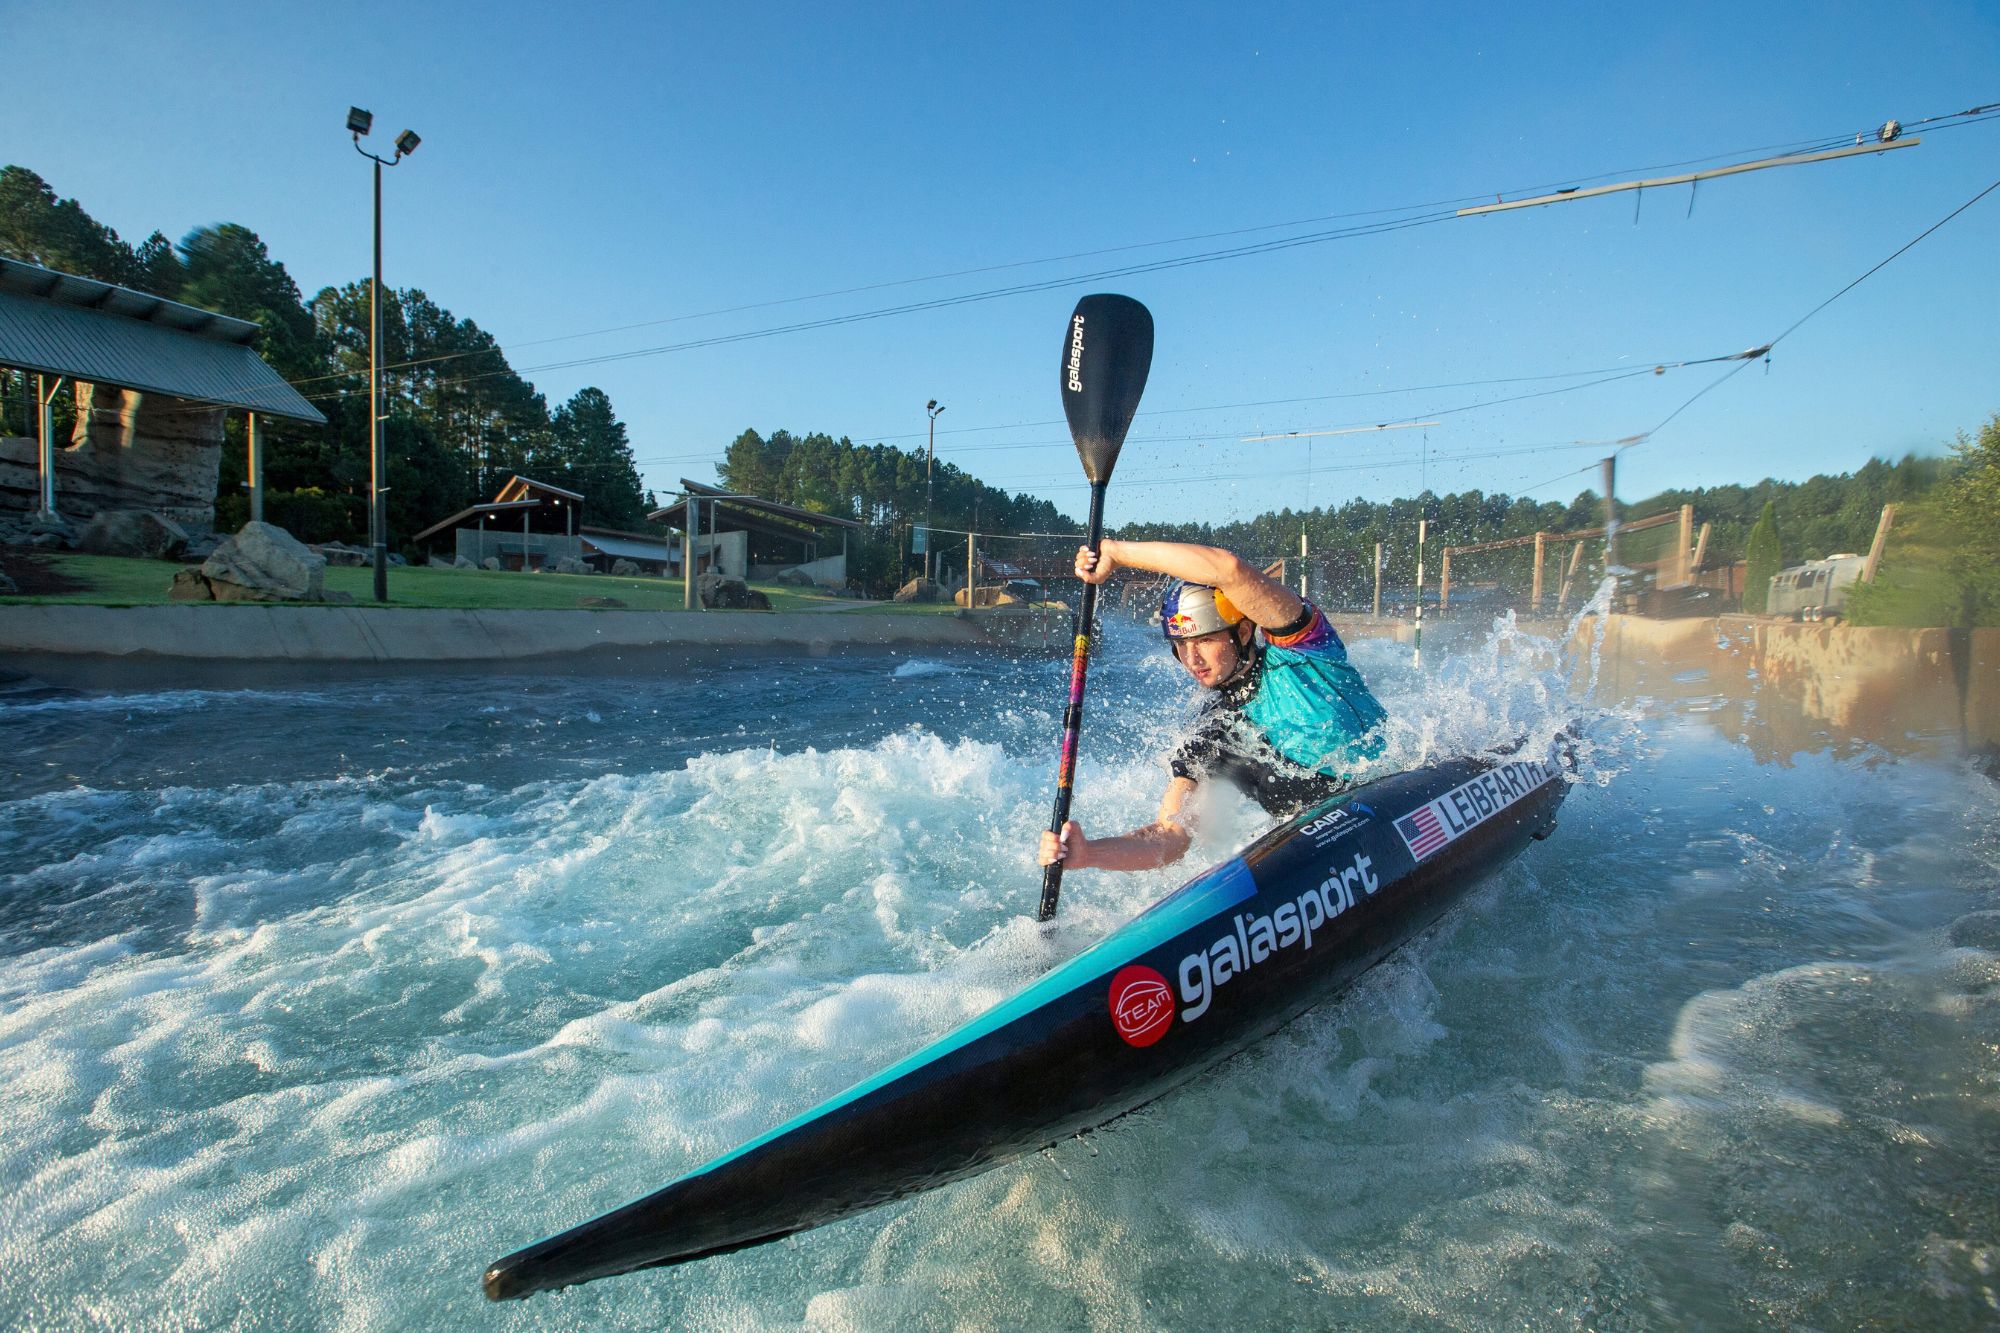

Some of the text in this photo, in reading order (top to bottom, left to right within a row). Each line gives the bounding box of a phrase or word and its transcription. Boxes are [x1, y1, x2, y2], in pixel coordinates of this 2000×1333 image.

[1067, 315, 1085, 392] galasport
[1299, 808, 1348, 836] CAIPI
[1178, 852, 1379, 1024] galasport
